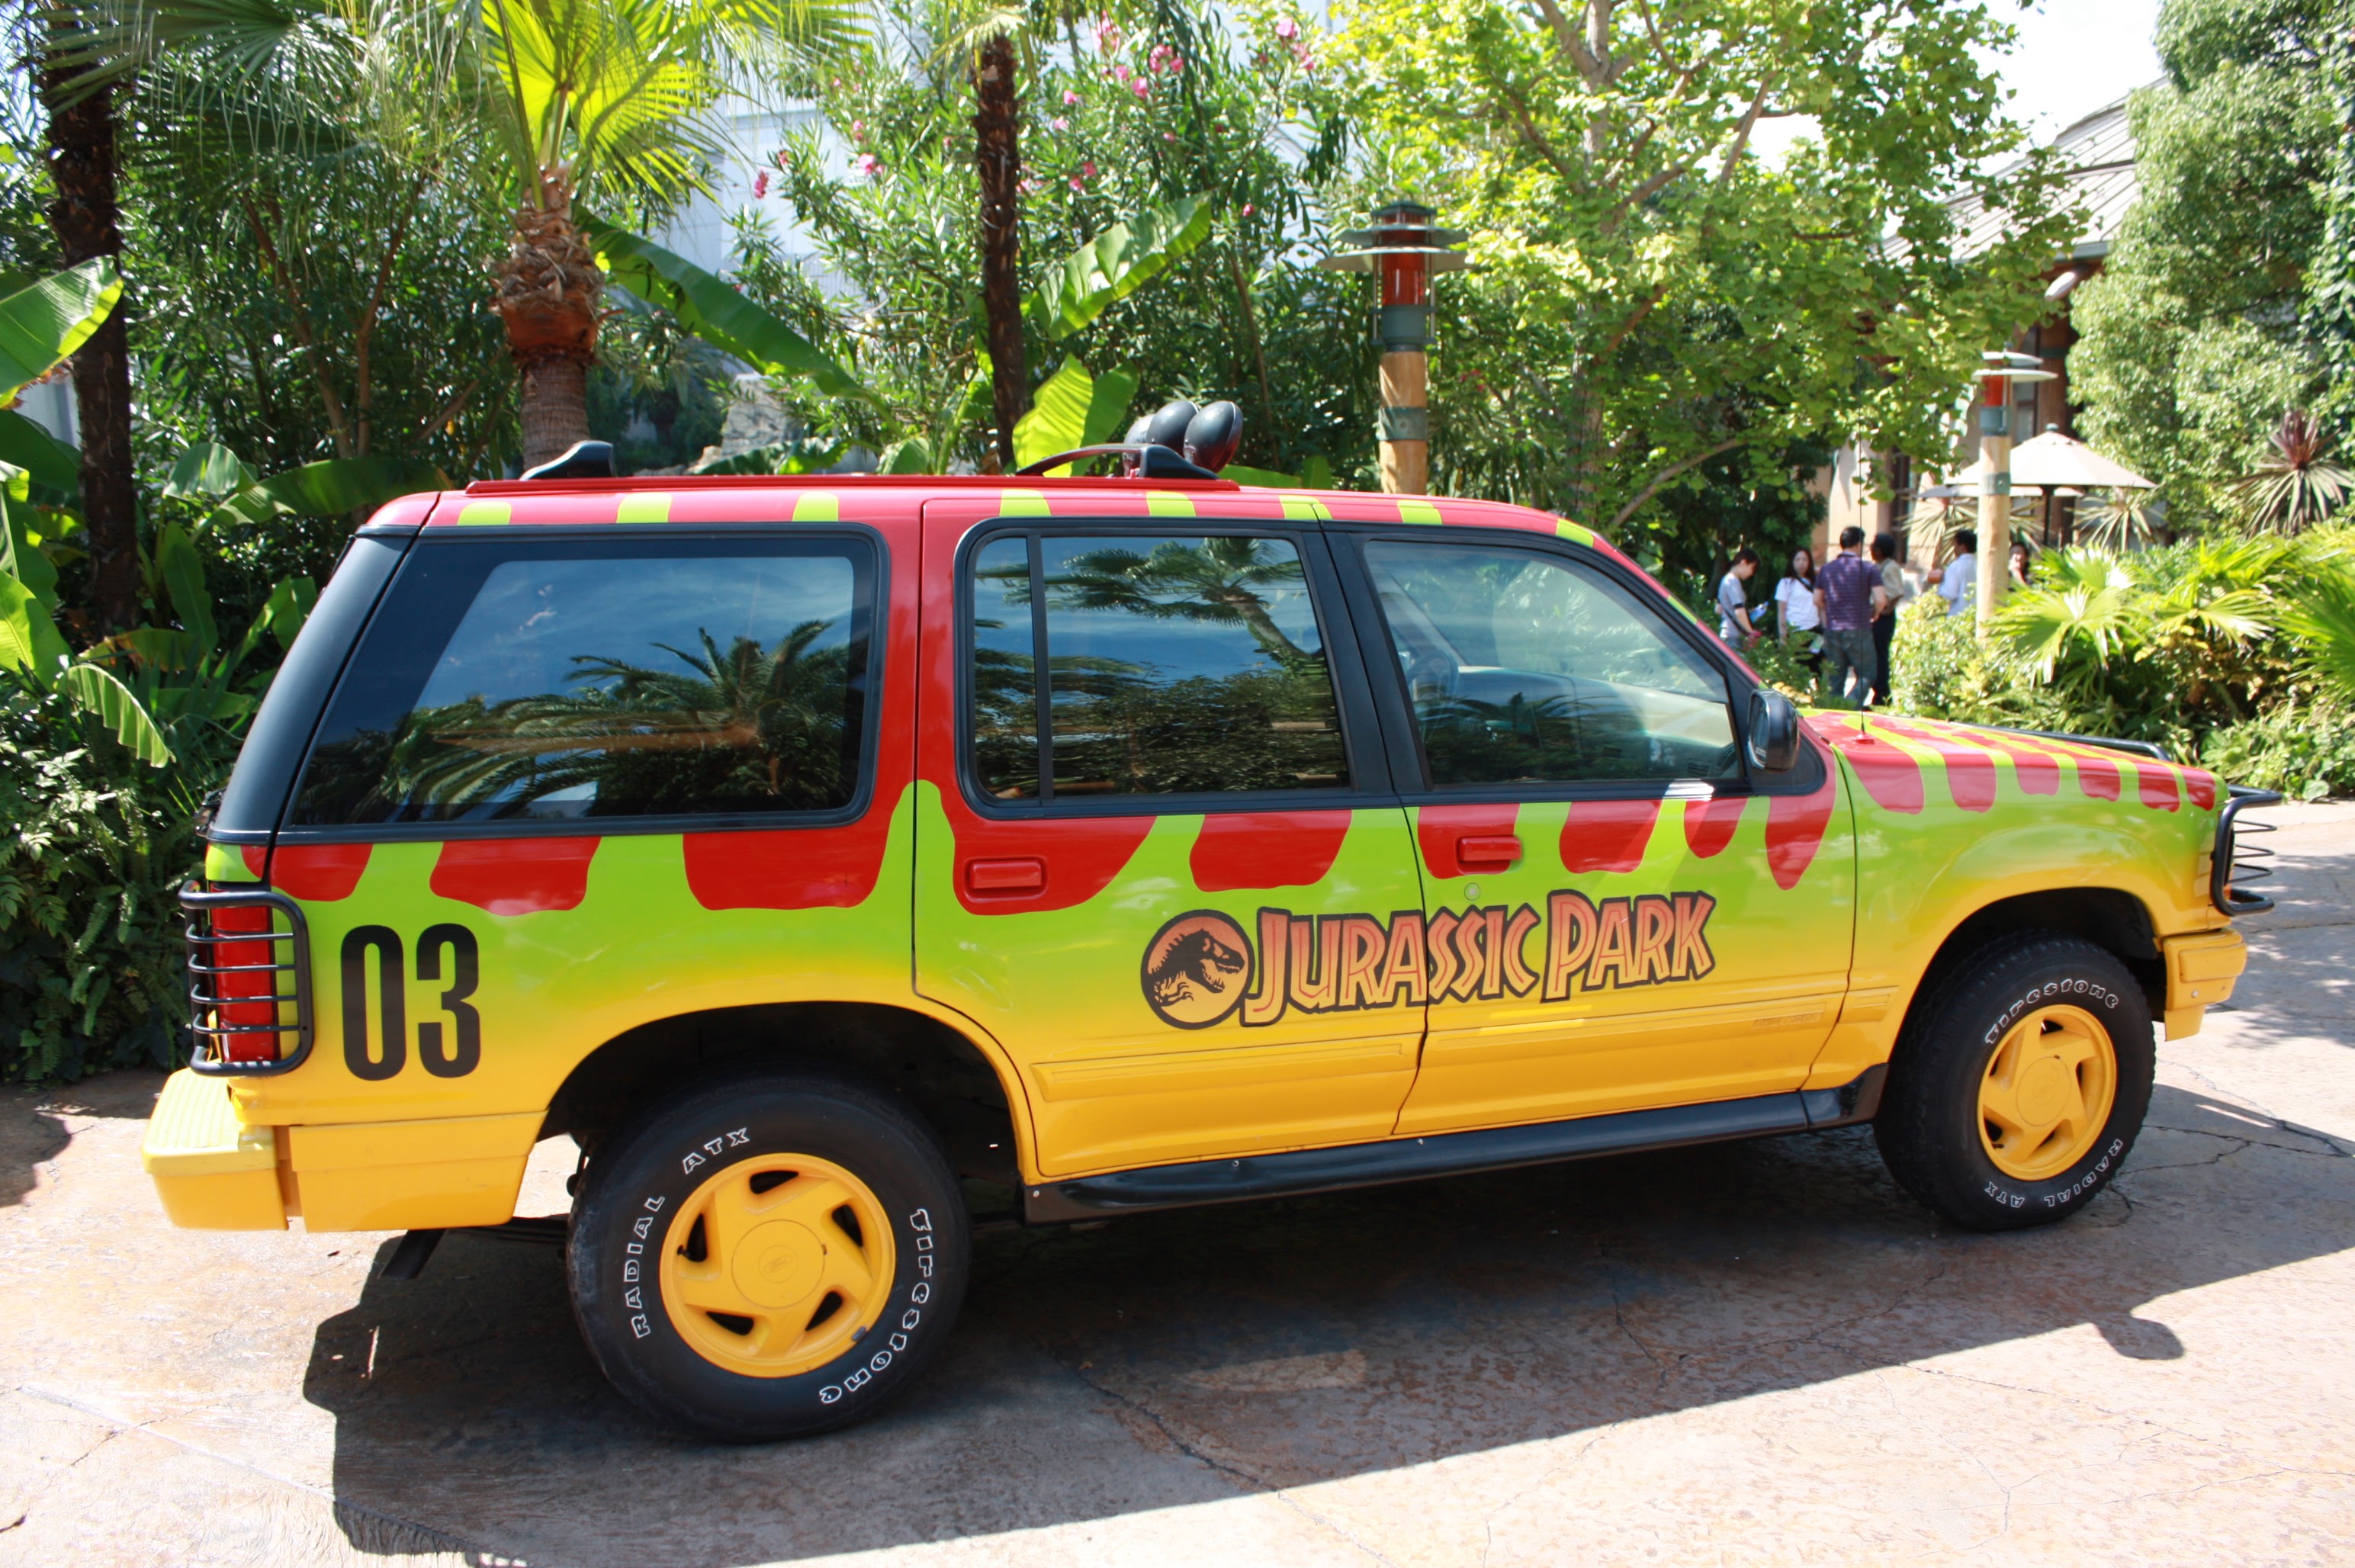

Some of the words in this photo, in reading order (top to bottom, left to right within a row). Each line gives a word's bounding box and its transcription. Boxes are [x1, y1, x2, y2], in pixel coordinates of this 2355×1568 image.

[341, 924, 481, 1081] 03
[1239, 902, 1541, 1027] JURASSIC
[1540, 888, 1716, 1003] PARK
[624, 1196, 665, 1338] RADIAL
[682, 1127, 751, 1174] ATX
[1984, 1181, 2025, 1208] ATX
[2044, 1139, 2123, 1207] RADIAL
